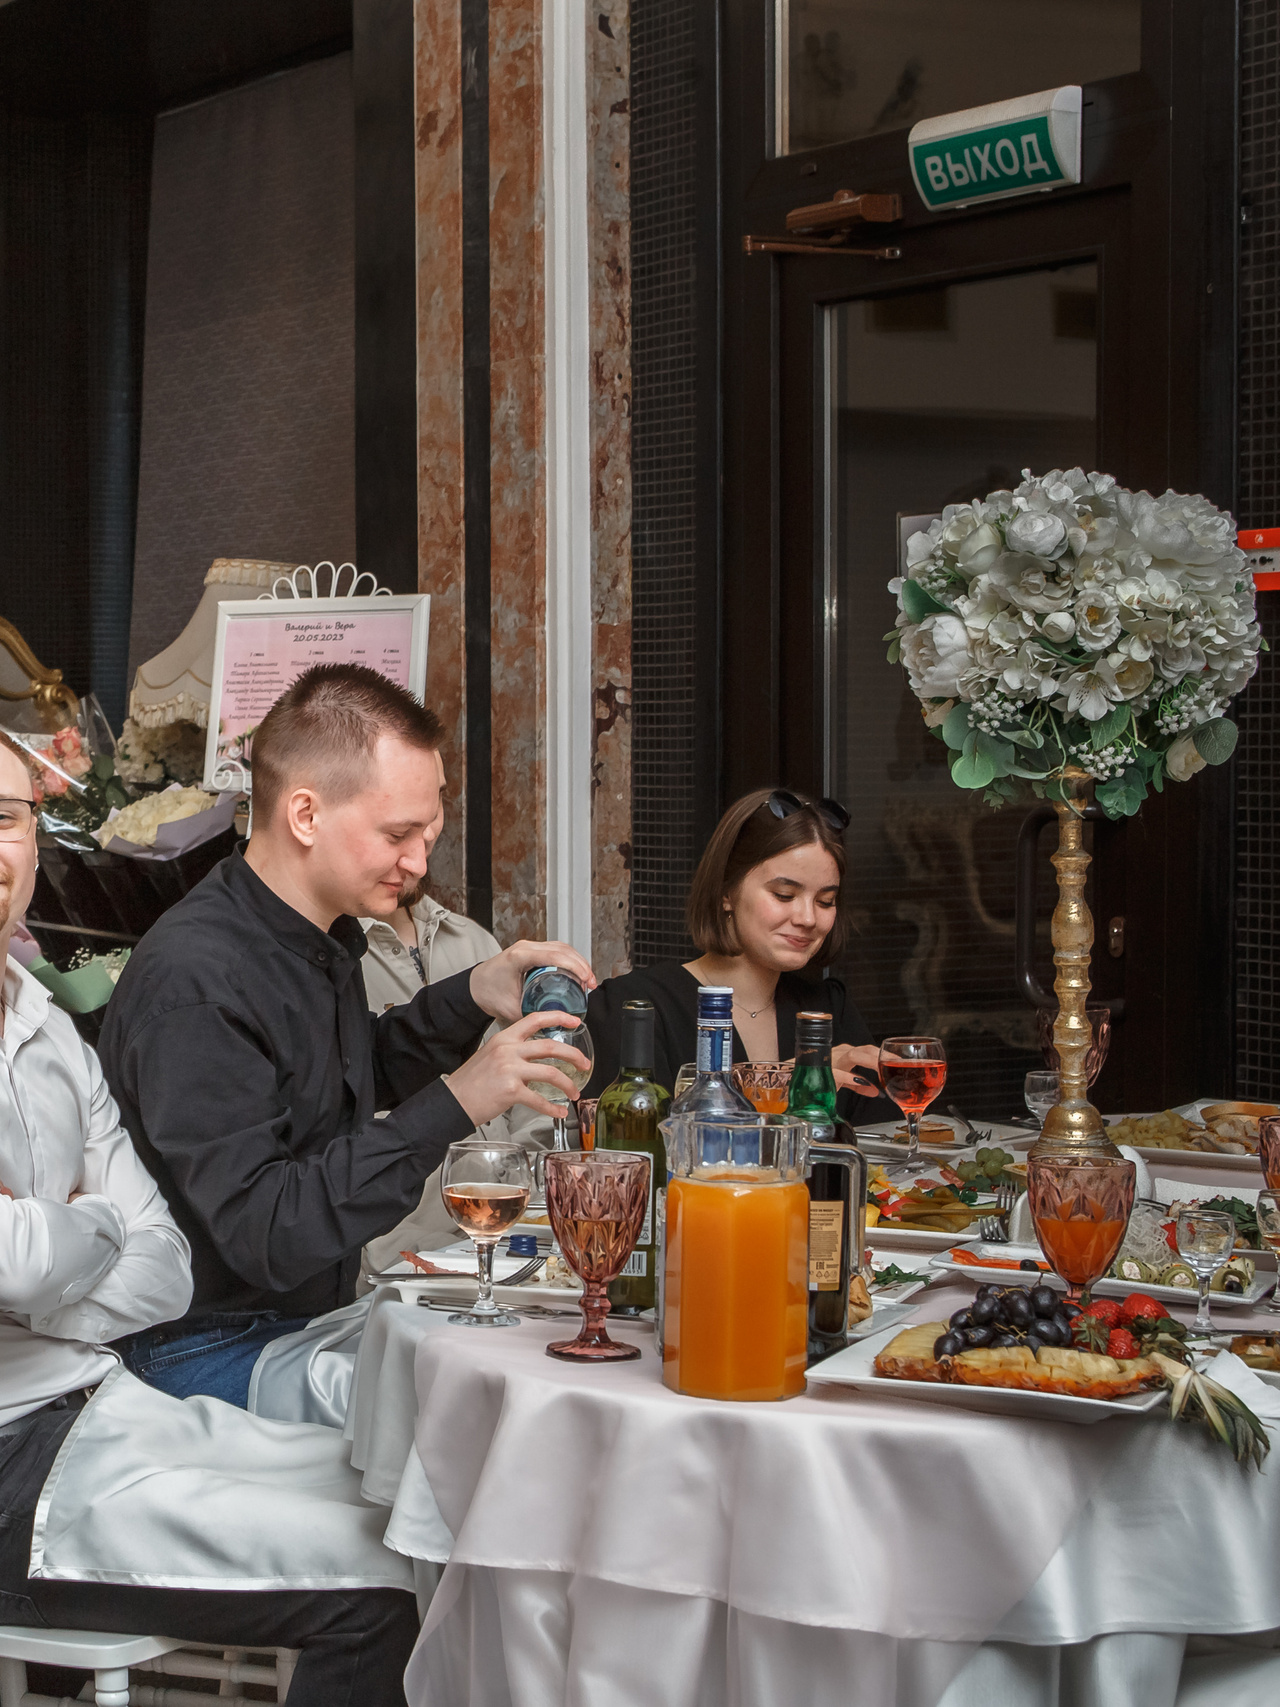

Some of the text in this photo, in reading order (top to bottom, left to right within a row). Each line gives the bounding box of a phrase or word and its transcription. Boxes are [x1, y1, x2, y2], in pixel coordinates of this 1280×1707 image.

[924, 133, 1052, 192] ВЫХОД
[284, 622, 323, 632] Валерий
[334, 621, 357, 631] Вера
[292, 633, 344, 643] 20.05.2023
